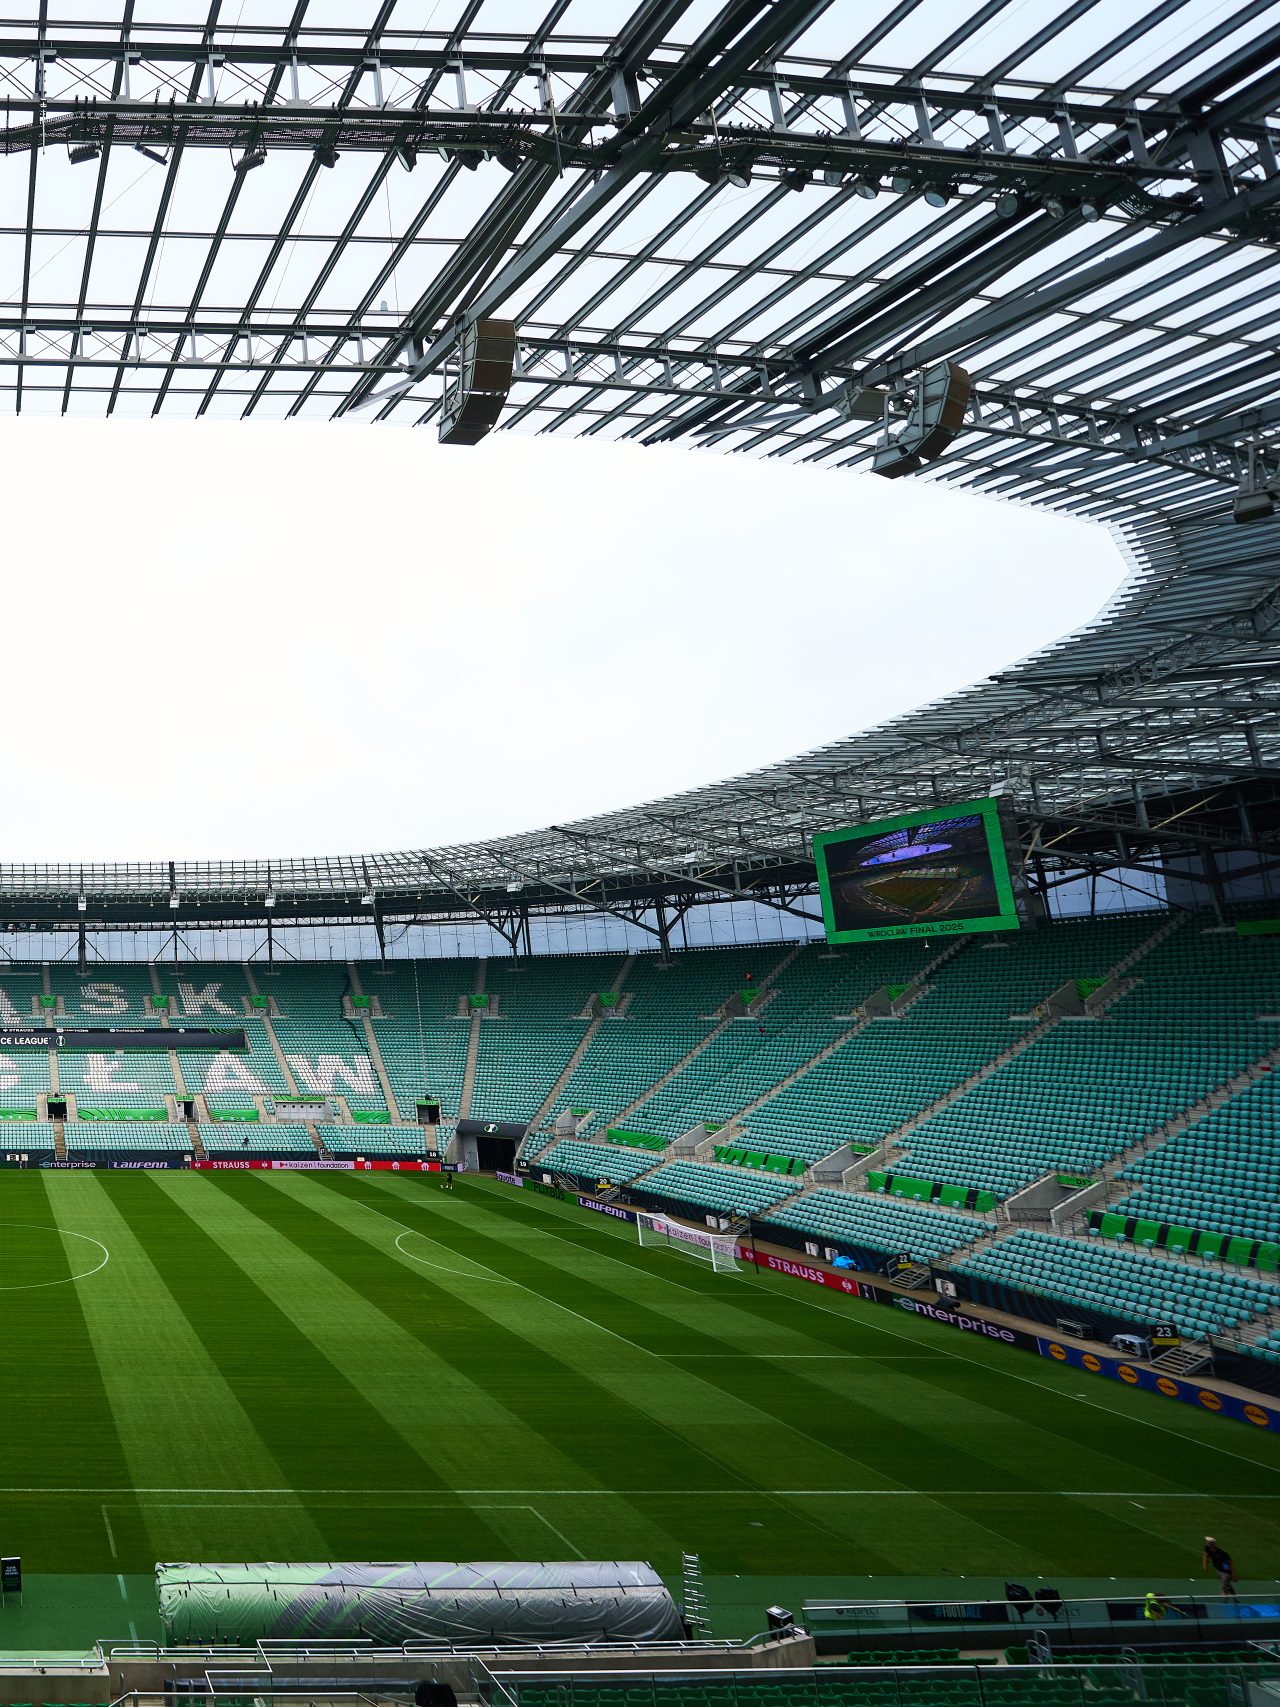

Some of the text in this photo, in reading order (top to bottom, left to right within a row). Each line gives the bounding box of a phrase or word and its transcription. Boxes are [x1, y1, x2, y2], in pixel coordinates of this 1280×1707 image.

[909, 926, 937, 935] FINAL
[939, 923, 964, 932] 2025
[14, 1037, 49, 1045] LEAGUE
[40, 1161, 96, 1169] enterprise
[212, 1161, 250, 1169] STRAUSS
[288, 1161, 349, 1169] kaizen foundation
[898, 1254, 908, 1263] 22
[768, 1256, 825, 1284] STRAUSS
[895, 1297, 1016, 1343] enterprise
[1156, 1326, 1172, 1338] 23
[846, 1607, 880, 1616] RESPECT
[934, 1605, 982, 1618] #FOOTBALL
